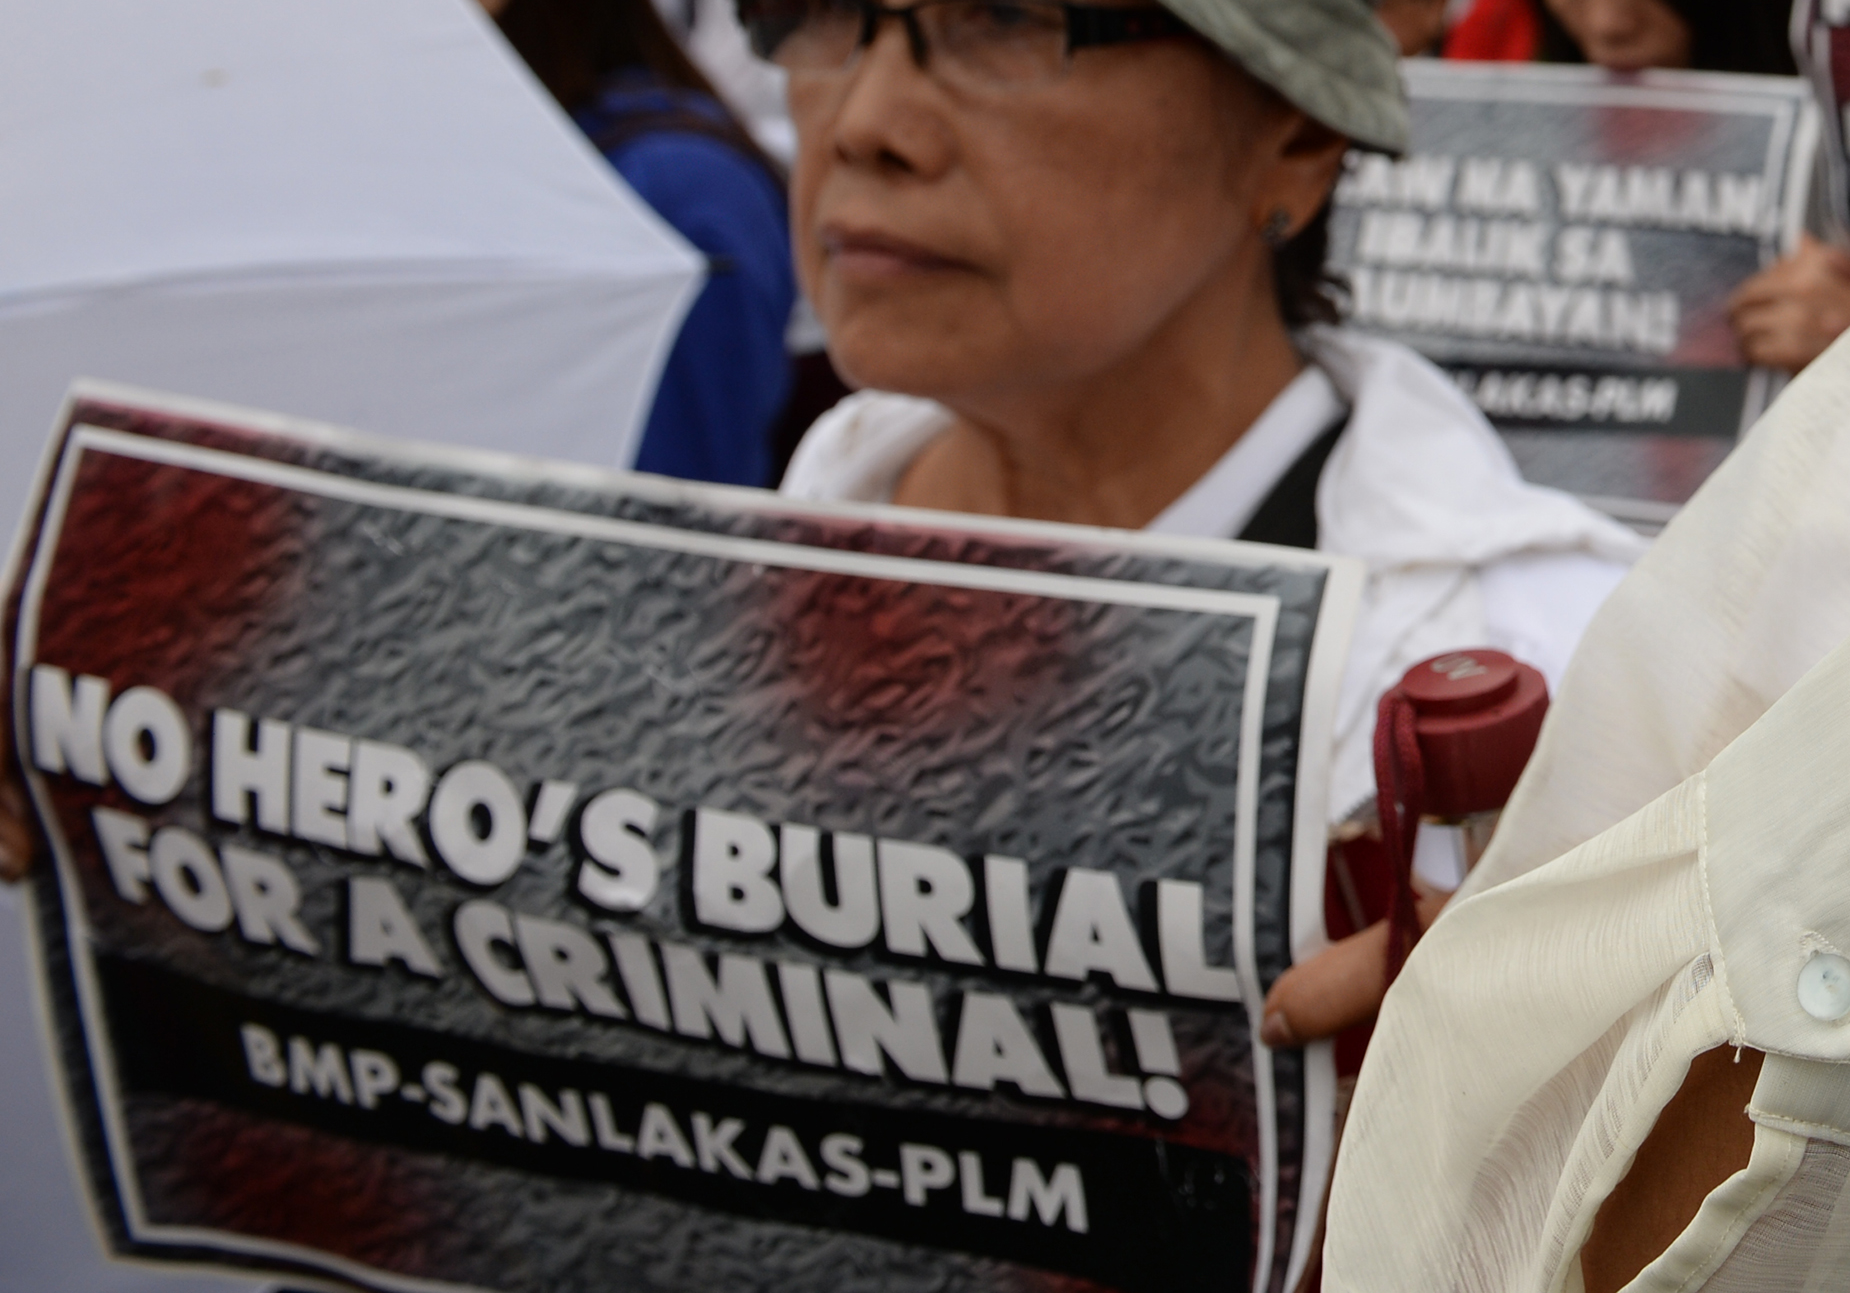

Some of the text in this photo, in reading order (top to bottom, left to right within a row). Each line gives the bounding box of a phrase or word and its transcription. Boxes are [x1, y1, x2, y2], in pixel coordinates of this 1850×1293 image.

[30, 664, 1244, 1004] NO HERO'S BURIAL
[94, 807, 1190, 1120] FOR A CRIMINAL!
[241, 1022, 1090, 1236] BMP-SANLAKAS-PLM
